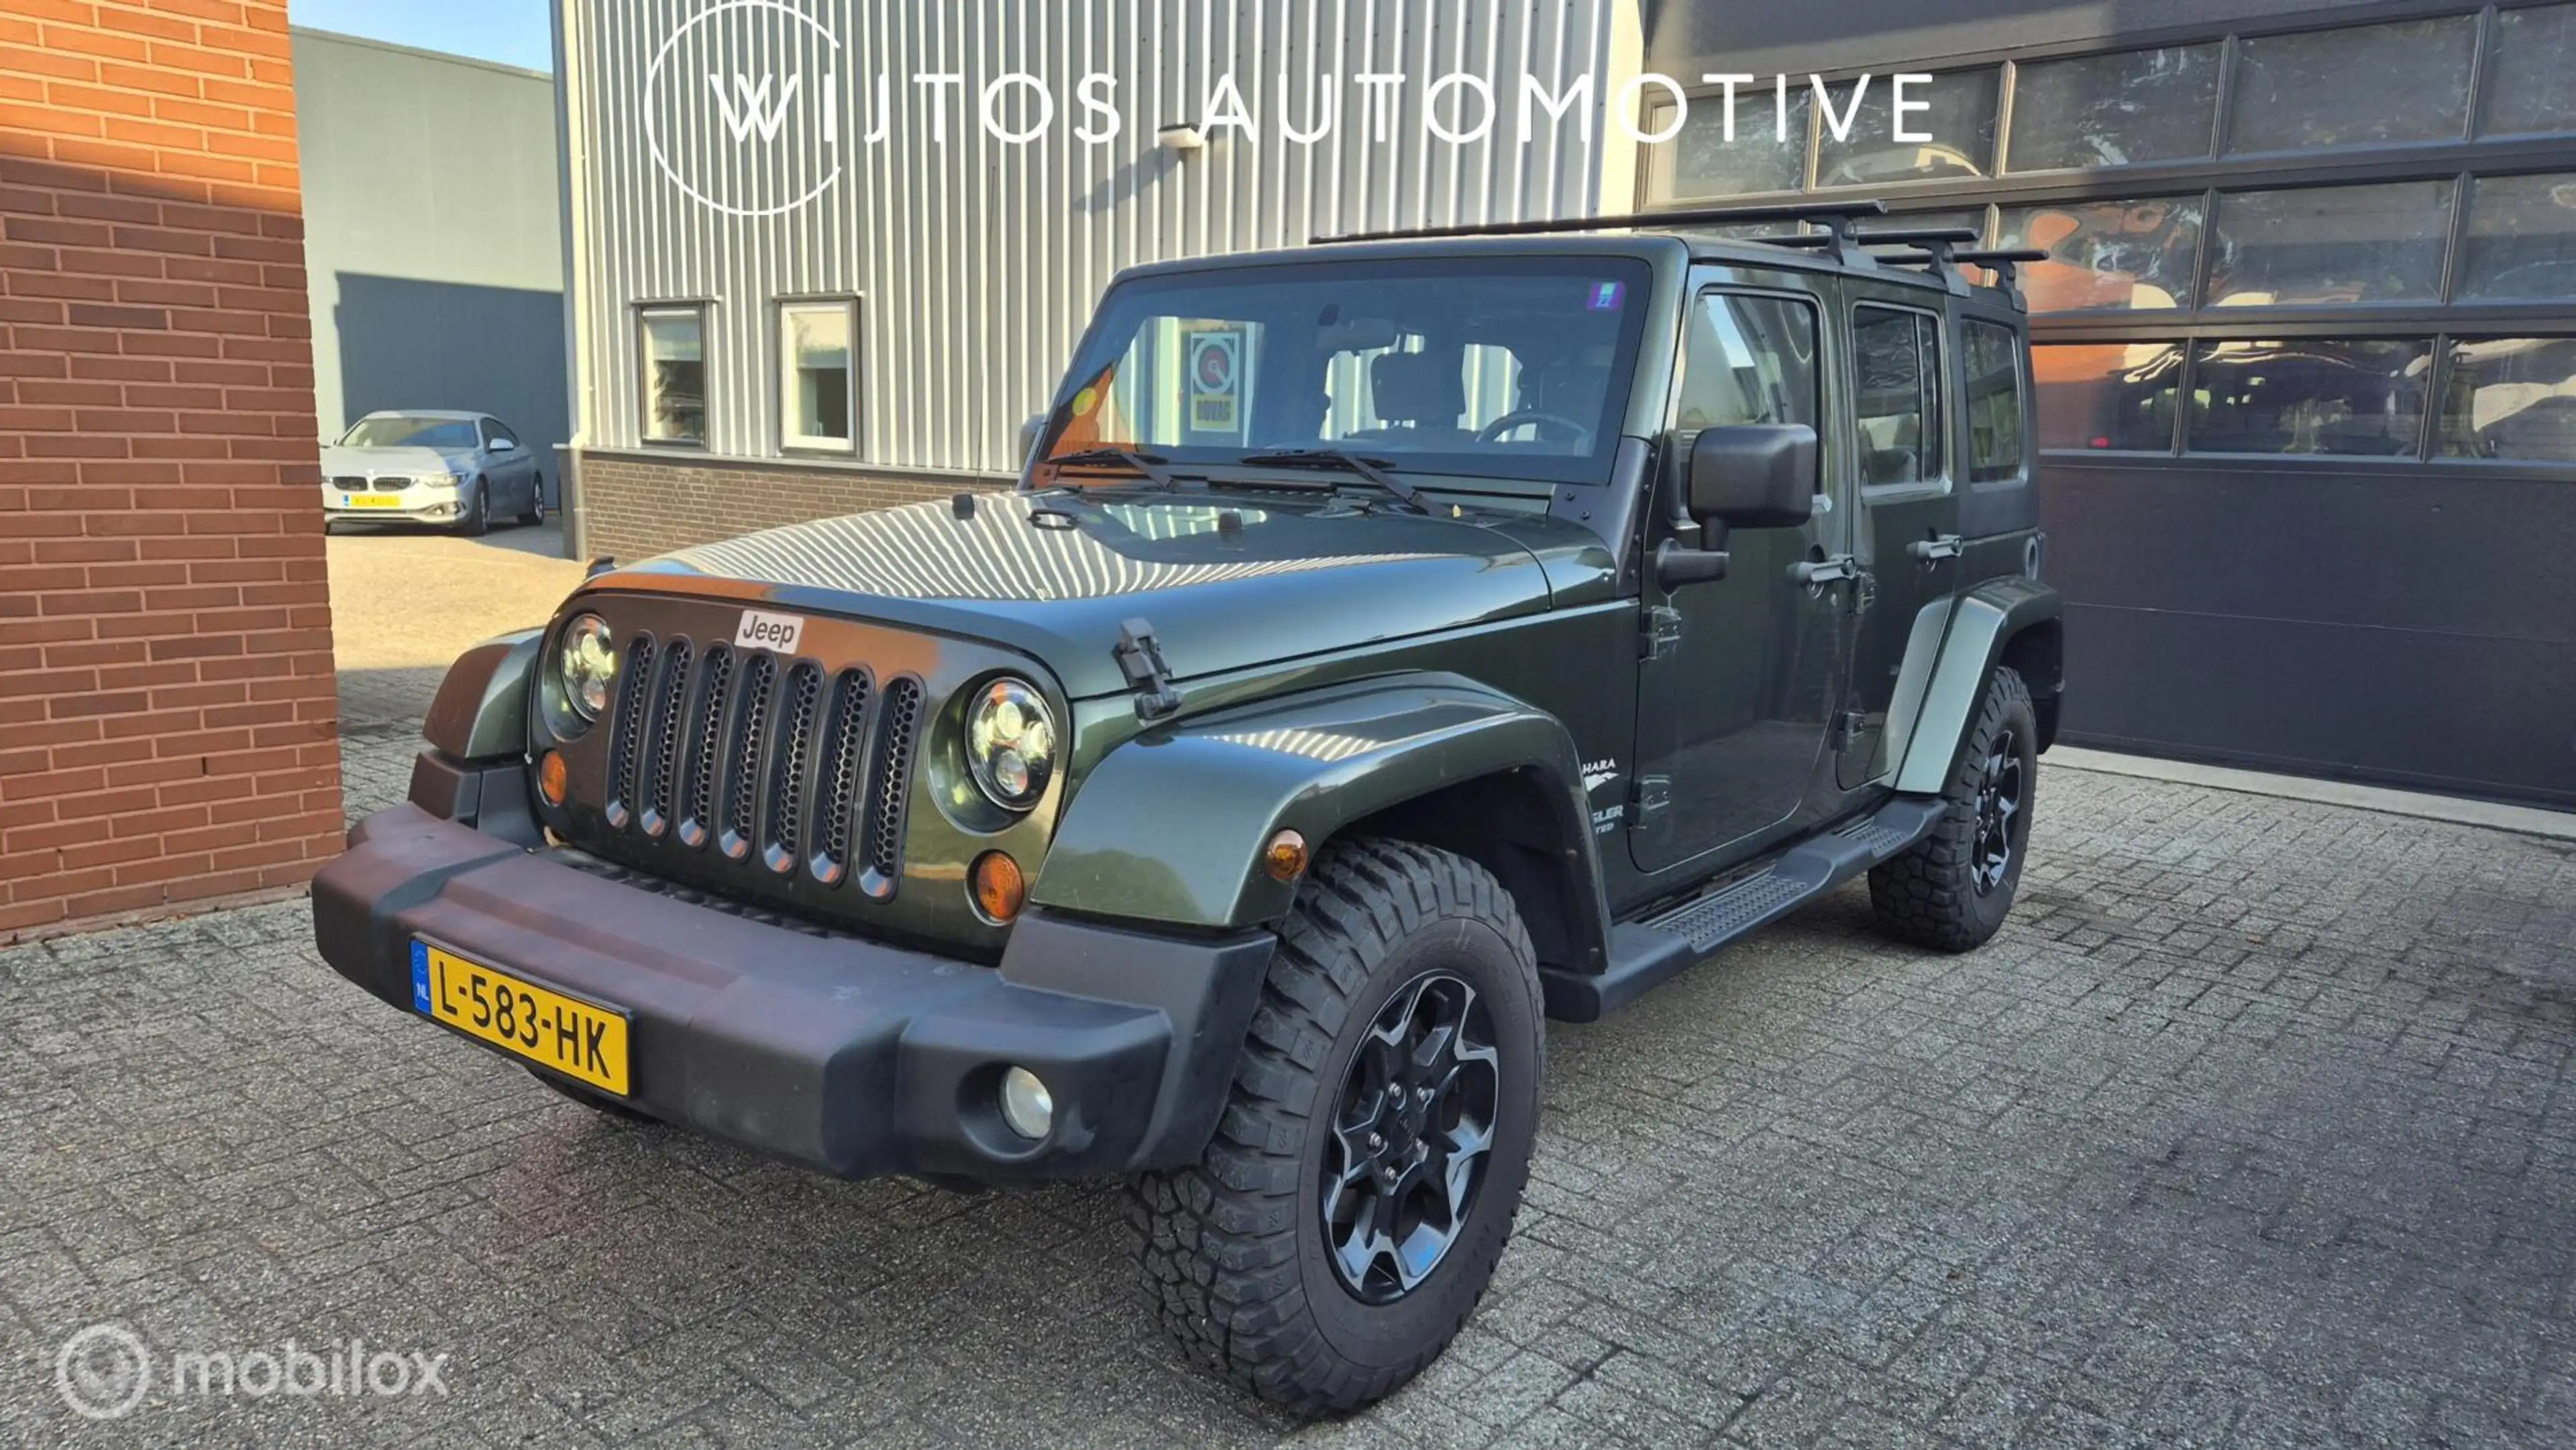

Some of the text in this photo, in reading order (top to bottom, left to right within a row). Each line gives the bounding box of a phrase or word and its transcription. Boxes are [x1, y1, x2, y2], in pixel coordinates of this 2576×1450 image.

[743, 615, 795, 649] Jeep
[1582, 757, 1616, 774] HARA
[439, 960, 611, 1079] L-583-HK
